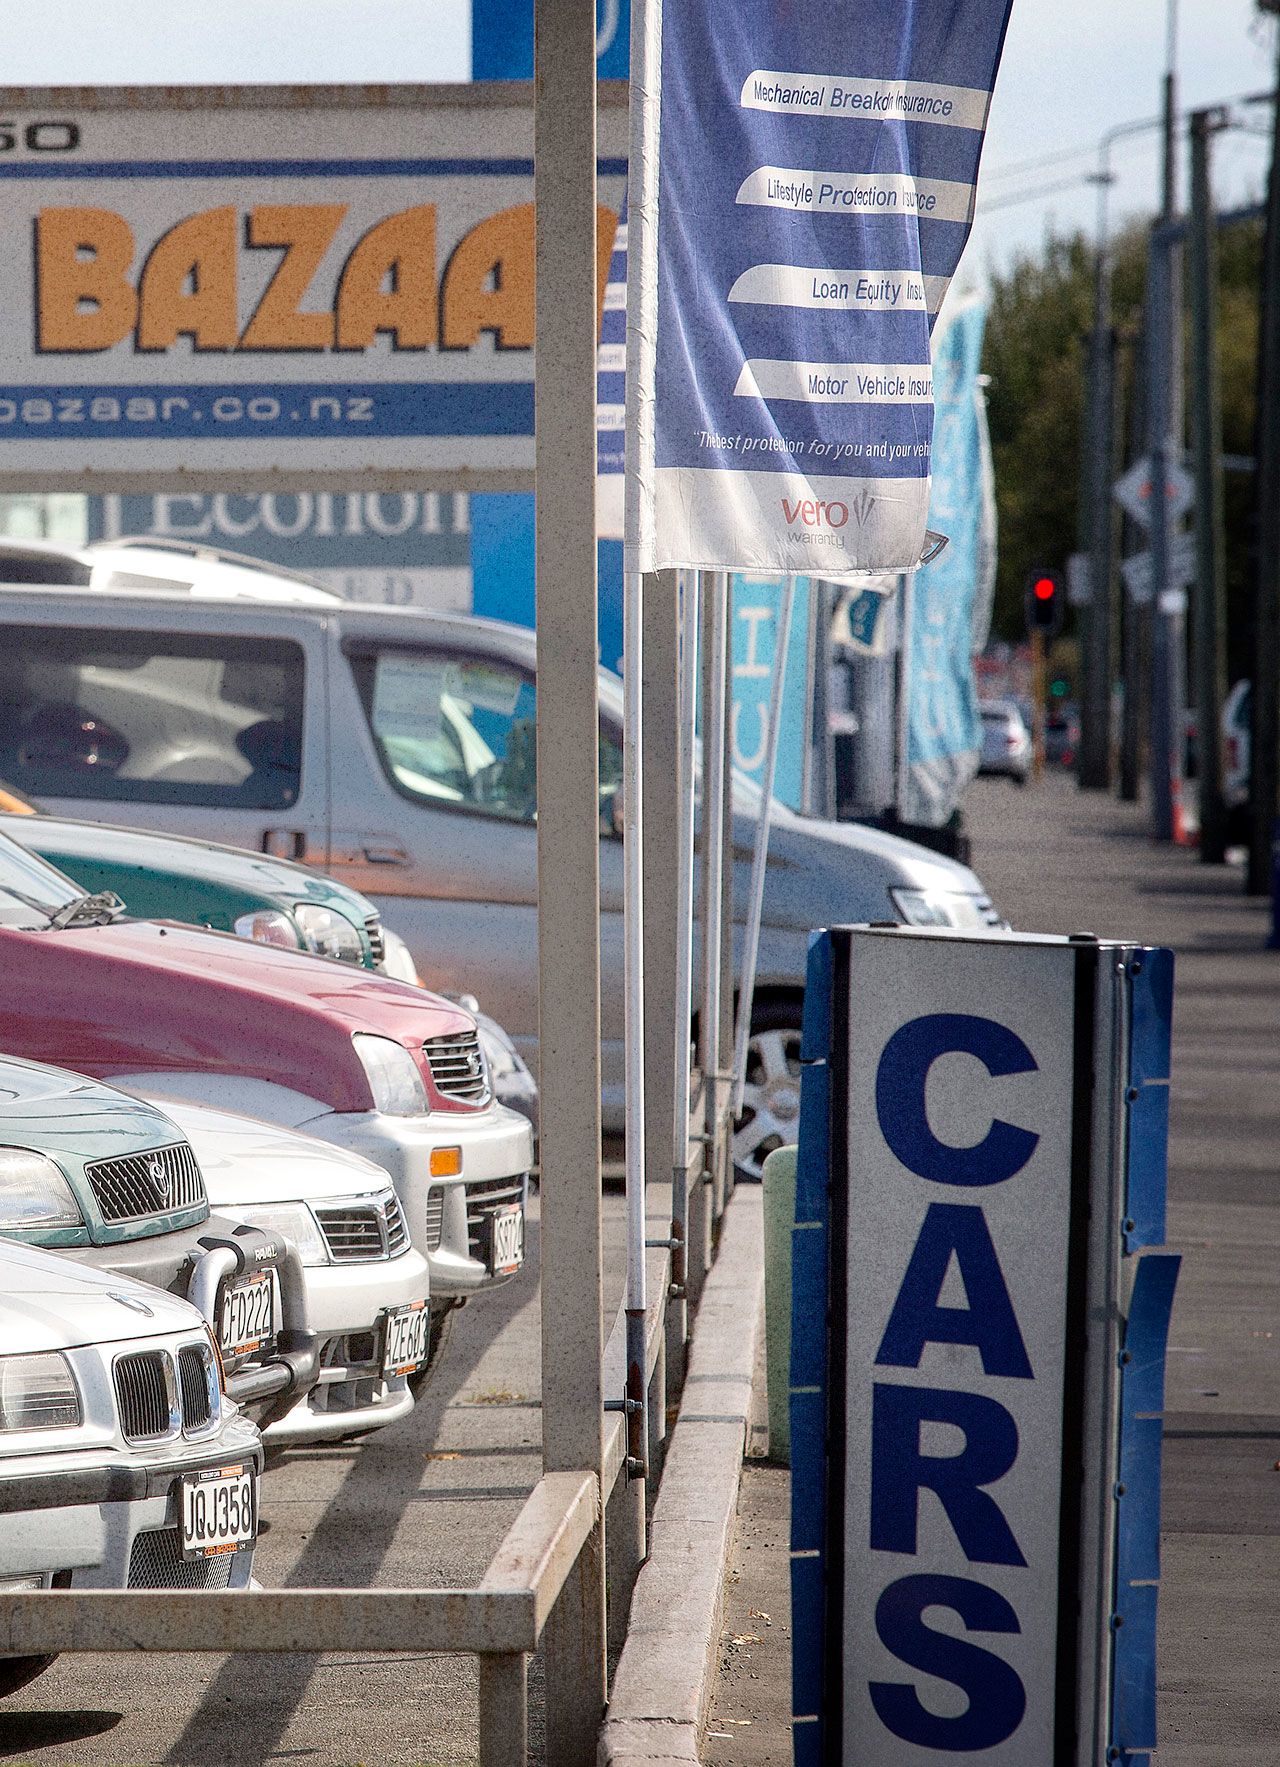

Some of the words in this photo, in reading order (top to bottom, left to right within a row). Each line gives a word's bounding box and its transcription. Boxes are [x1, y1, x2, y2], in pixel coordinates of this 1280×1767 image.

[753, 80, 825, 107] Mechanical
[895, 90, 953, 116] Insurance
[767, 178, 813, 207] Lifestyle
[819, 183, 898, 207] Protection
[812, 277, 849, 300] Loan
[855, 278, 902, 306] Equity
[808, 374, 849, 396] Motor
[857, 375, 905, 396] Vehicle
[741, 435, 804, 454] protection
[808, 439, 833, 456] for
[833, 443, 862, 460] you
[865, 440, 887, 458] and
[888, 443, 912, 462] your
[781, 498, 849, 528] vero
[787, 531, 845, 549] warranty
[222, 1284, 270, 1345] CFD222
[868, 1012, 1040, 1751] CARS
[184, 1483, 251, 1542] JQJ358
